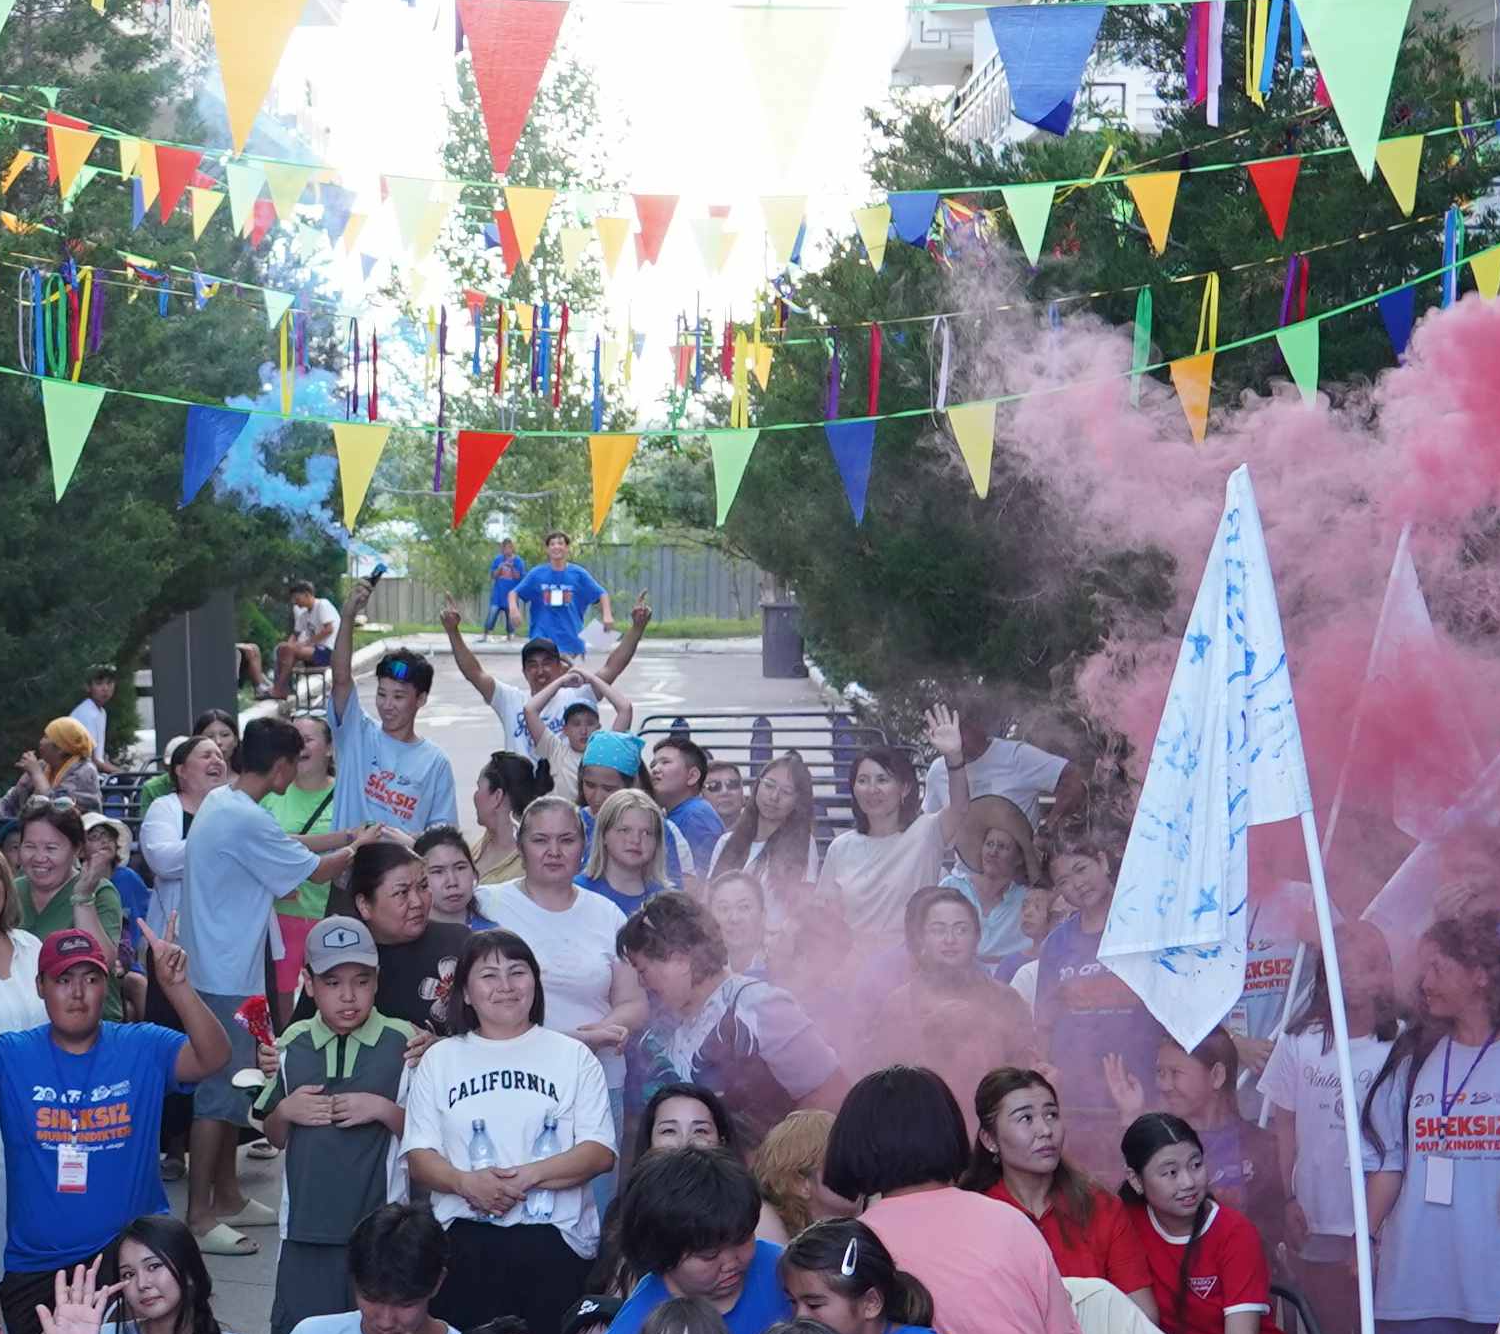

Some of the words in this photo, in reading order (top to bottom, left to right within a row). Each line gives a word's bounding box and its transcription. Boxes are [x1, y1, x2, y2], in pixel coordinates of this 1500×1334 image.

[1246, 958, 1292, 979] EKSIZ
[449, 1070, 559, 1108] CALIFORNIA
[36, 1103, 131, 1129] SHKSIZ
